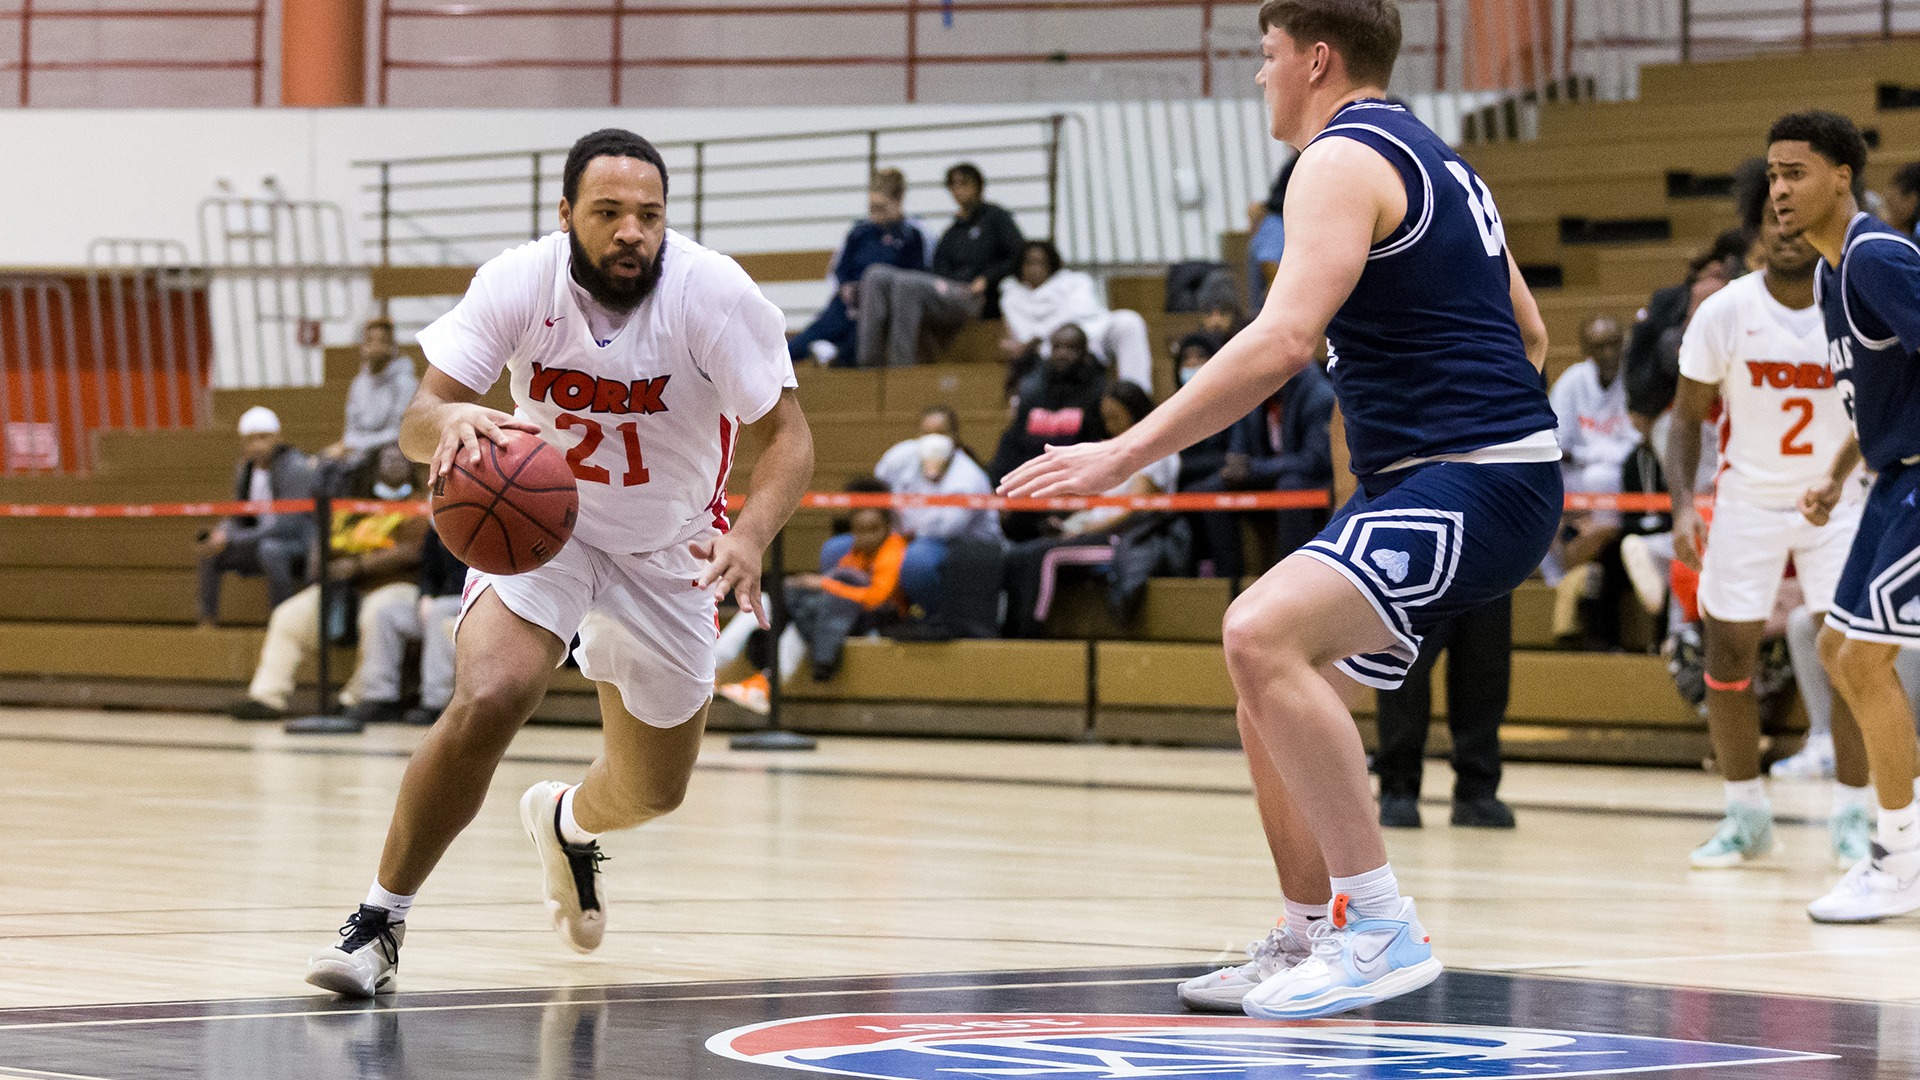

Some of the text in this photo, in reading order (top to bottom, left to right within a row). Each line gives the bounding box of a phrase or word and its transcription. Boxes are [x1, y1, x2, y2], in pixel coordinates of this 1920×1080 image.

[529, 362, 671, 415] YORK
[555, 413, 650, 486] 21
[1779, 397, 1814, 456] 2
